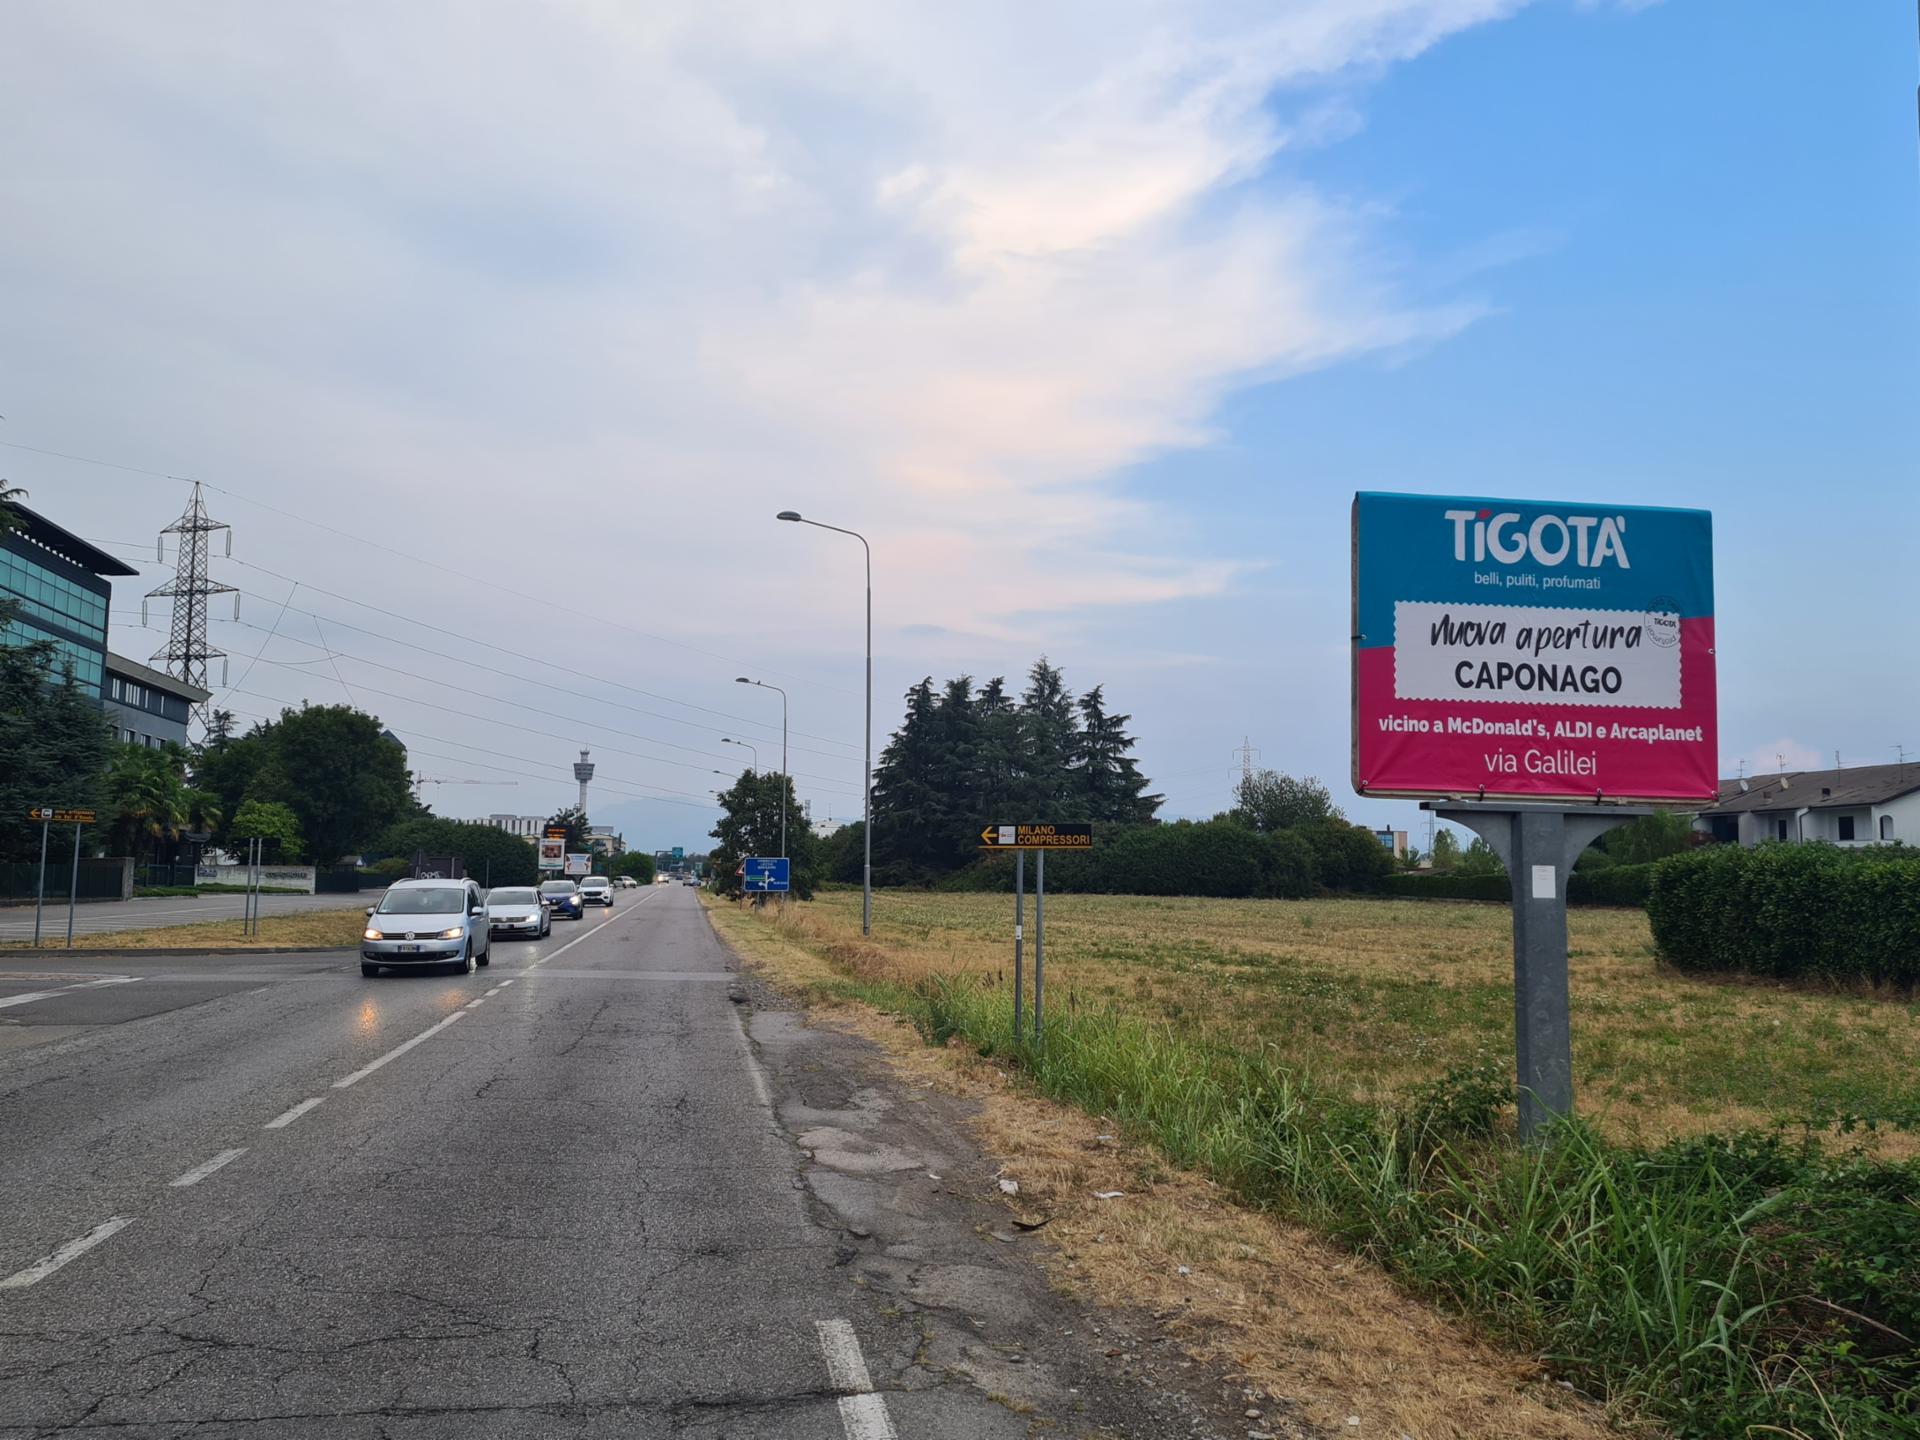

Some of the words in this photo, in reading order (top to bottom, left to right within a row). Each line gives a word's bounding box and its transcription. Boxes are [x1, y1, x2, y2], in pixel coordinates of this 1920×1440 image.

[1474, 571, 1502, 586] belli,
[1506, 574, 1539, 589] puliti,
[1543, 575, 1601, 589] profumati
[1430, 613, 1507, 648] Nuova
[1516, 619, 1642, 657] apertura
[1455, 660, 1622, 694] CAPONAGO
[1378, 714, 1430, 733] vicino
[1433, 720, 1444, 733] a
[1447, 717, 1550, 740] McDonald's,
[1554, 721, 1592, 738] ALDI
[1596, 725, 1607, 738] e
[1610, 722, 1703, 744] Arcaplanet
[1484, 748, 1518, 773] via
[1524, 749, 1597, 775] Galilei
[1017, 825, 1056, 835] MILANO
[1017, 835, 1090, 845] COMPRESSORI
